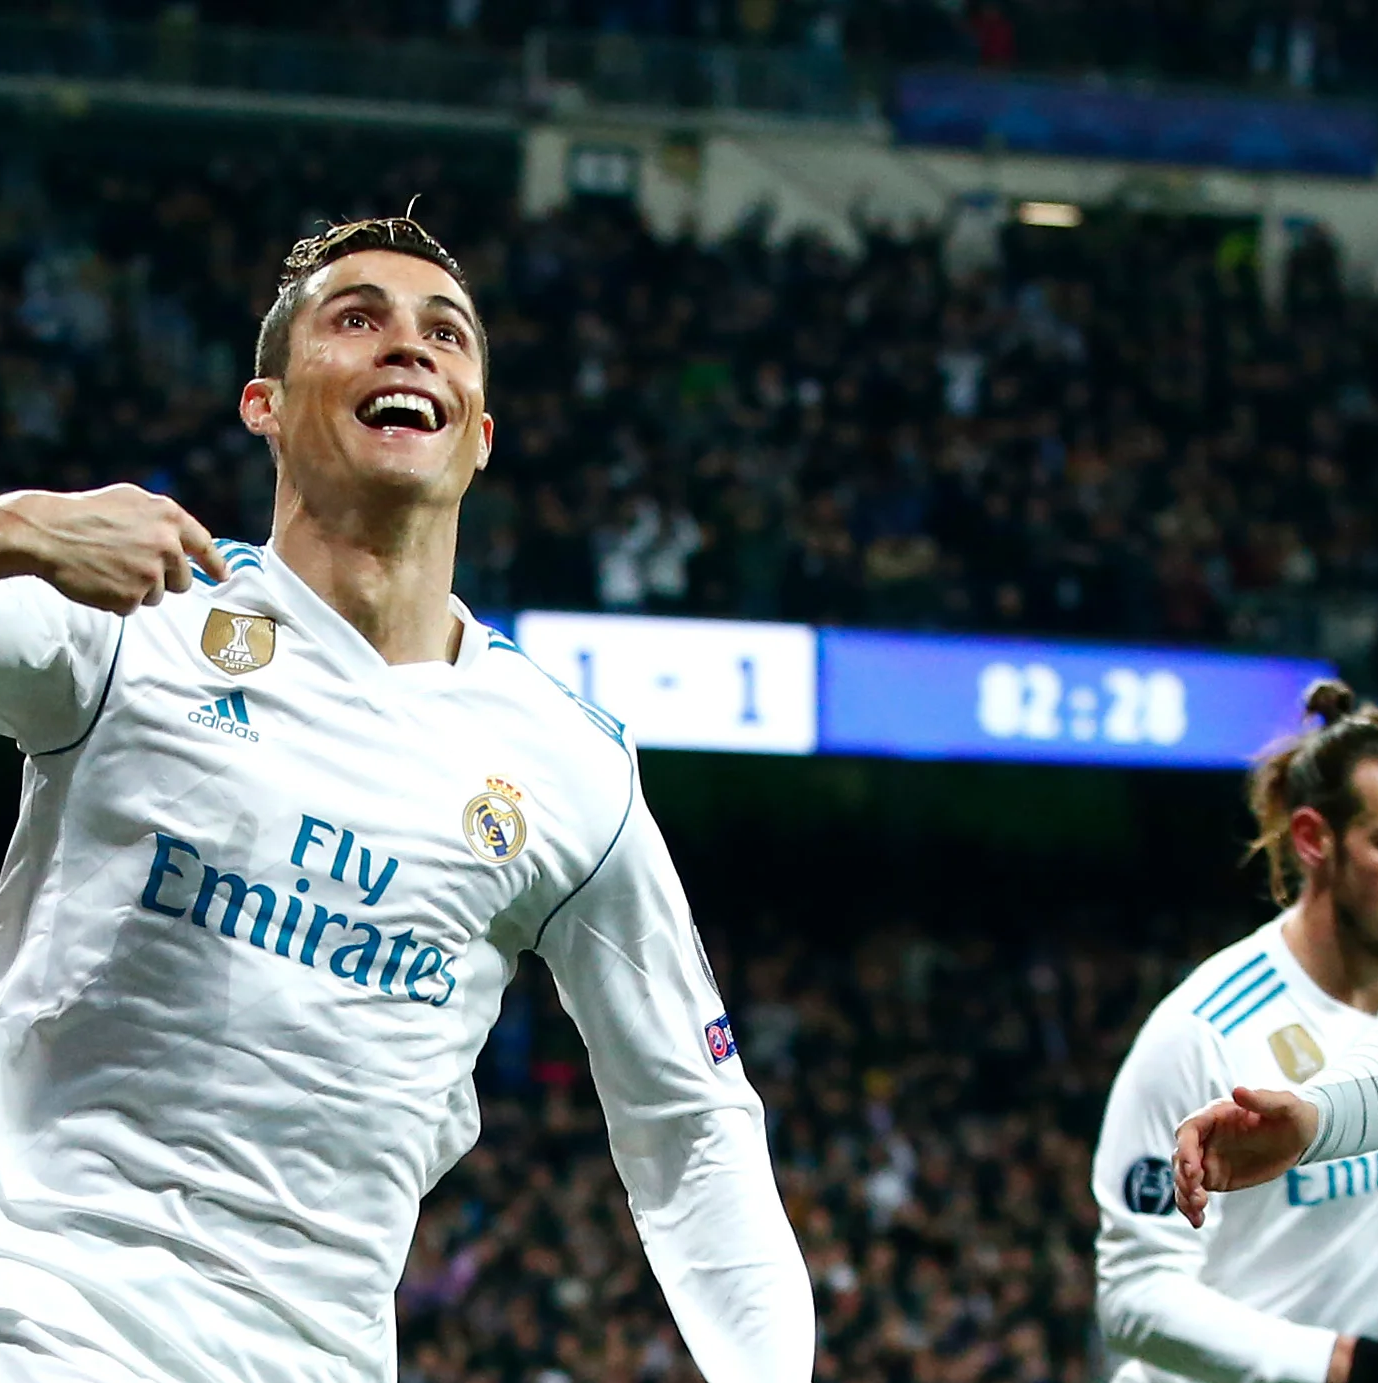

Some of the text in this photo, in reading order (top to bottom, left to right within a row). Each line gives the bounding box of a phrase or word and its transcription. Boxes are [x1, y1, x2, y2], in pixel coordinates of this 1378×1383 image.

[219, 648, 256, 663] FIFA
[734, 656, 762, 726] 1
[187, 710, 260, 743] adidas
[290, 813, 399, 906] Fly
[141, 831, 458, 1007] Emirates
